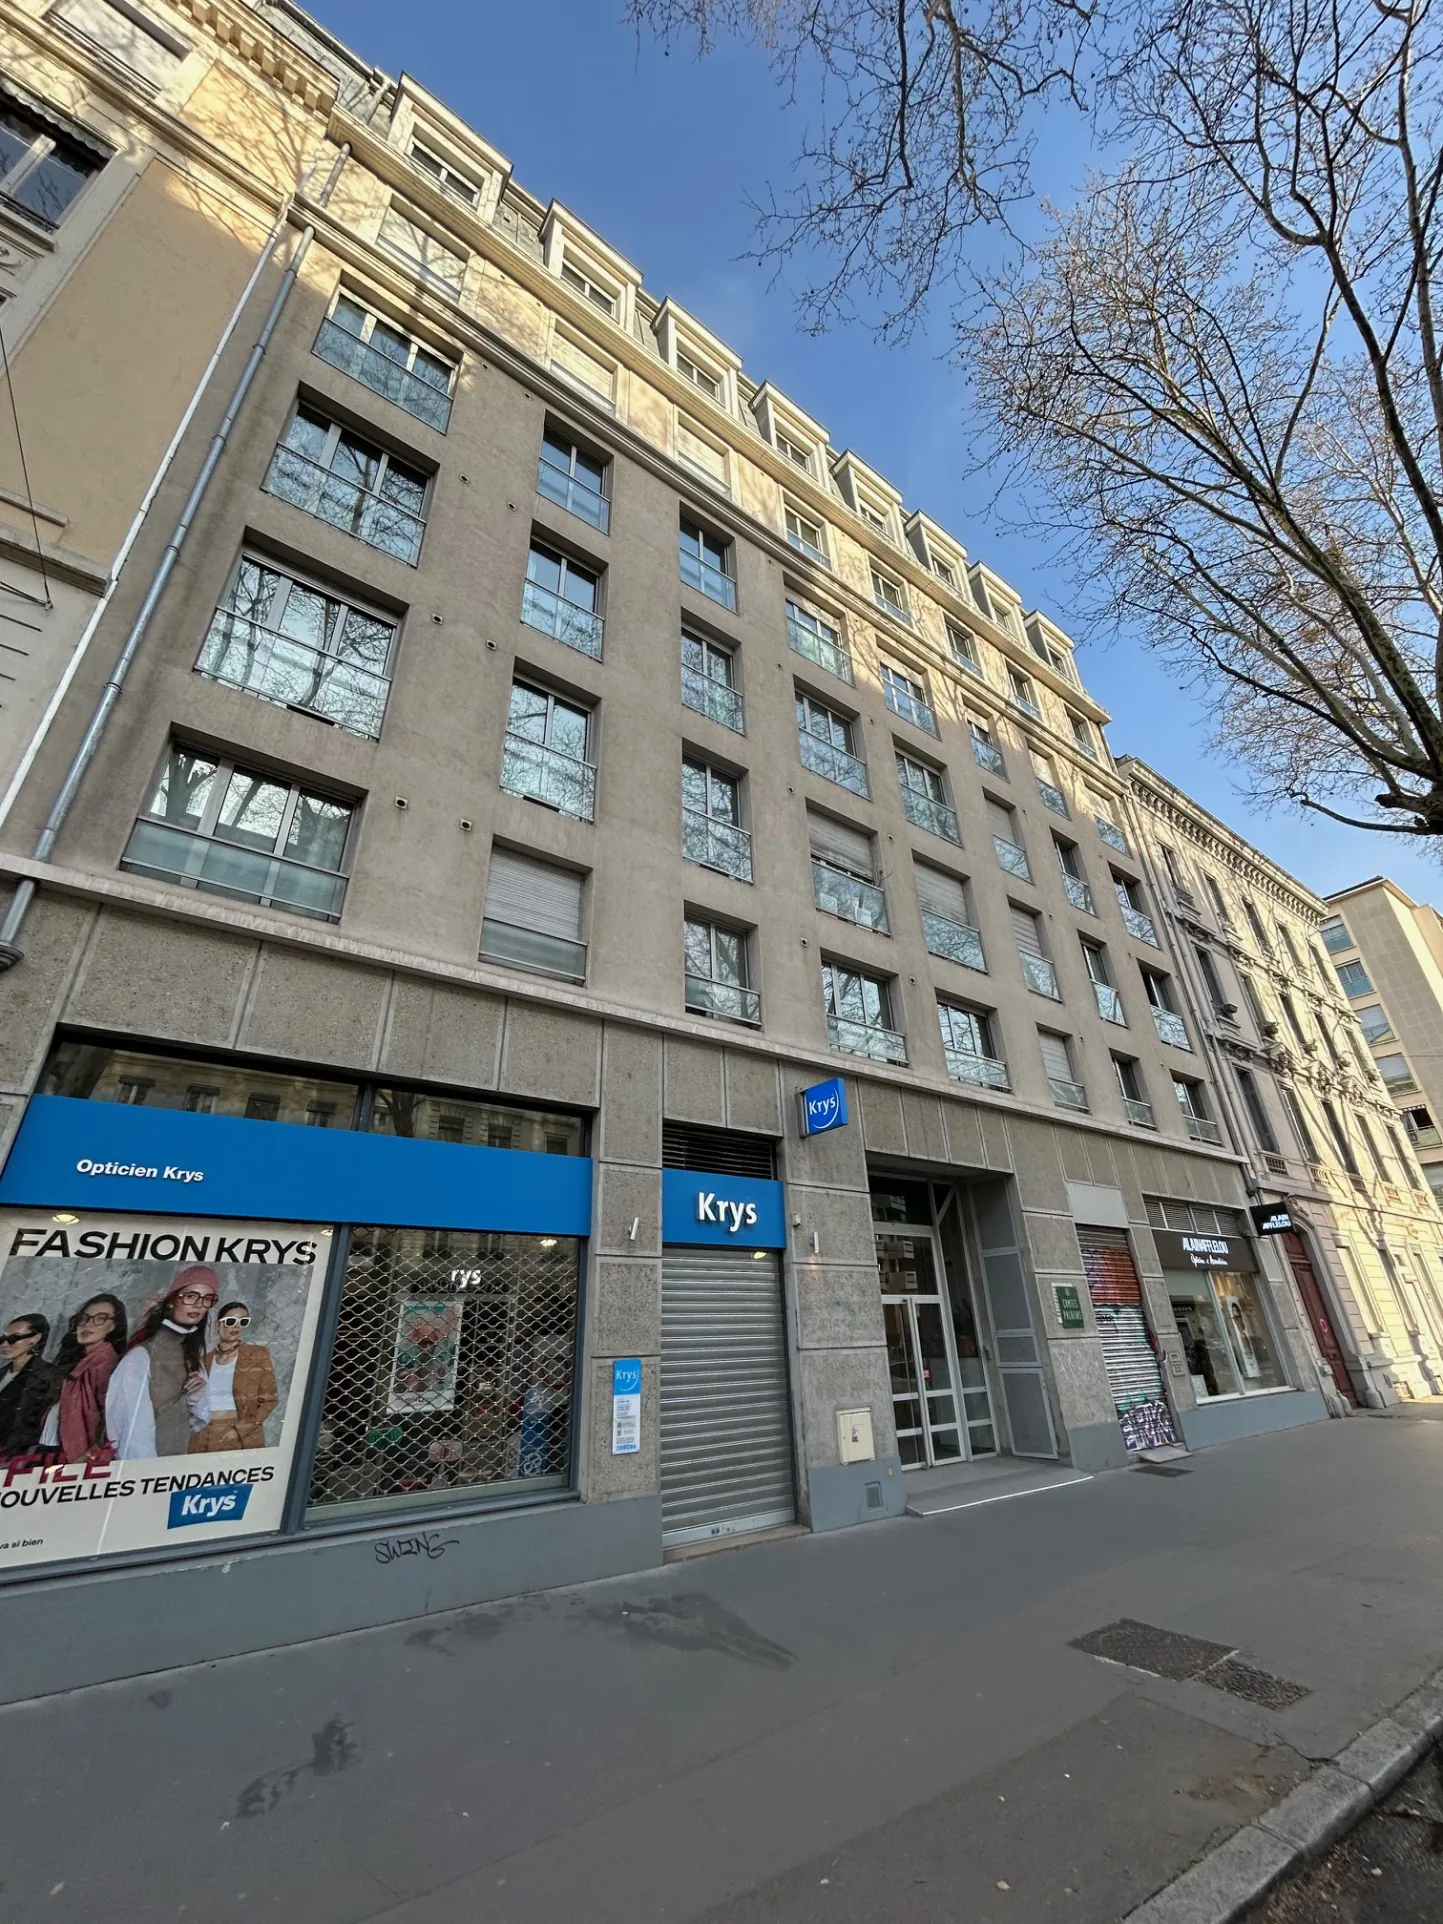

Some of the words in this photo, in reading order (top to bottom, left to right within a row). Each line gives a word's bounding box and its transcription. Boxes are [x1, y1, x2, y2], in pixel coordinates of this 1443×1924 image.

[808, 1095, 836, 1115] Krys
[76, 1158, 158, 1178] Opticien
[163, 1166, 204, 1183] Krys
[698, 1192, 758, 1232] Krys
[9, 1228, 209, 1262] FASHION
[215, 1237, 318, 1266] KRYS
[616, 1370, 637, 1383] Krys
[0, 1479, 136, 1509] OUVELLES
[140, 1466, 275, 1495] TENDANCES
[181, 1493, 237, 1518] Krys
[11, 1539, 21, 1549] si
[22, 1538, 44, 1548] bien
